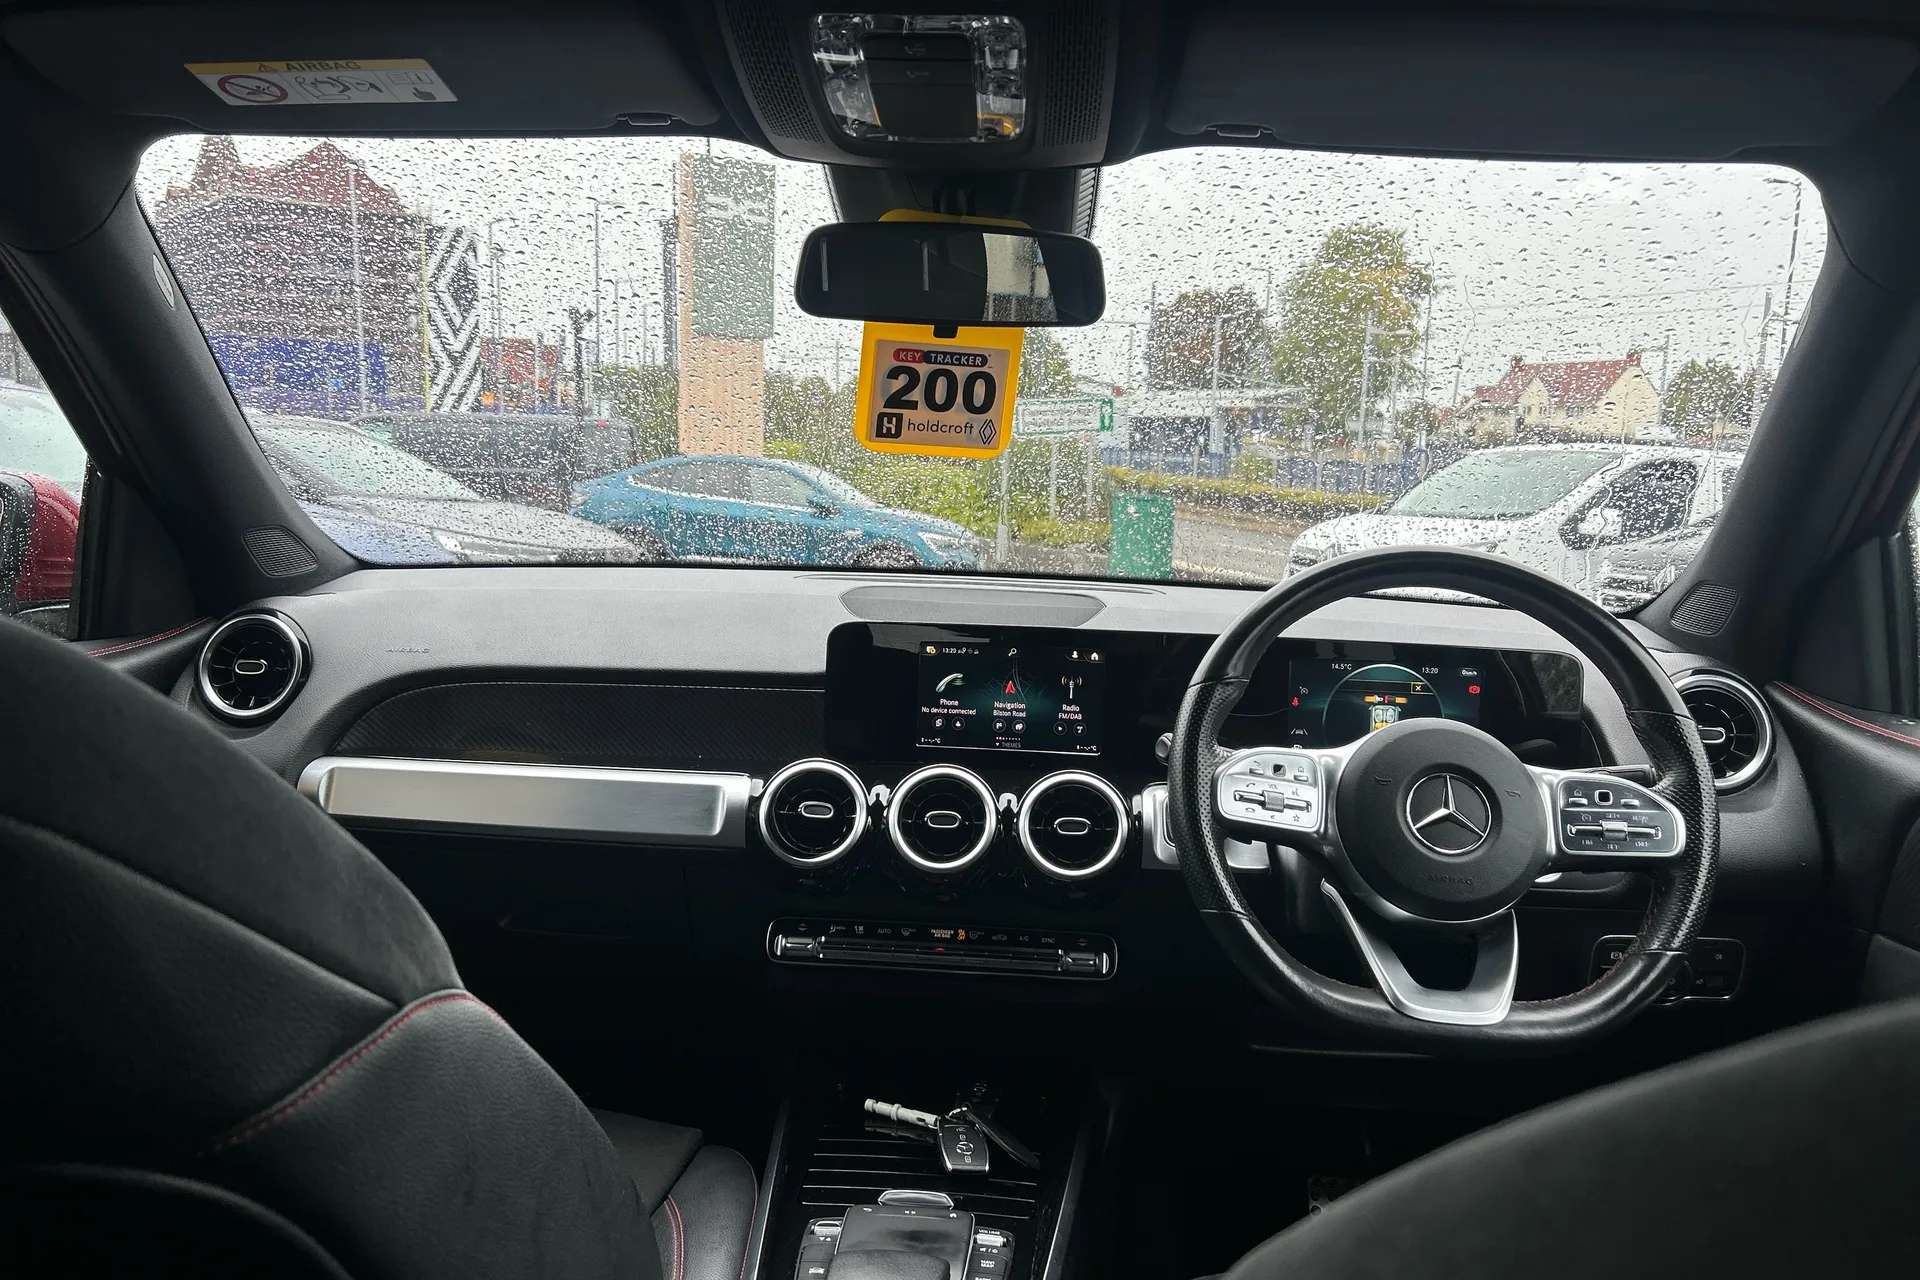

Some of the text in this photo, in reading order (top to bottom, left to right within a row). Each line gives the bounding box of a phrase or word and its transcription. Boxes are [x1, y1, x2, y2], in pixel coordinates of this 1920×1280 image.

[286, 61, 361, 72] AIRBAG
[899, 351, 982, 366] KEY TRACKER
[883, 365, 996, 415] 200
[907, 418, 974, 435] holdcroft
[1421, 667, 1438, 675] 13:20
[940, 698, 959, 706] Phone
[994, 701, 1026, 710] Navigation
[948, 707, 977, 715] connected
[1062, 704, 1080, 712] Radio
[1012, 710, 1026, 718] Road
[1058, 712, 1082, 720] FM/DAB
